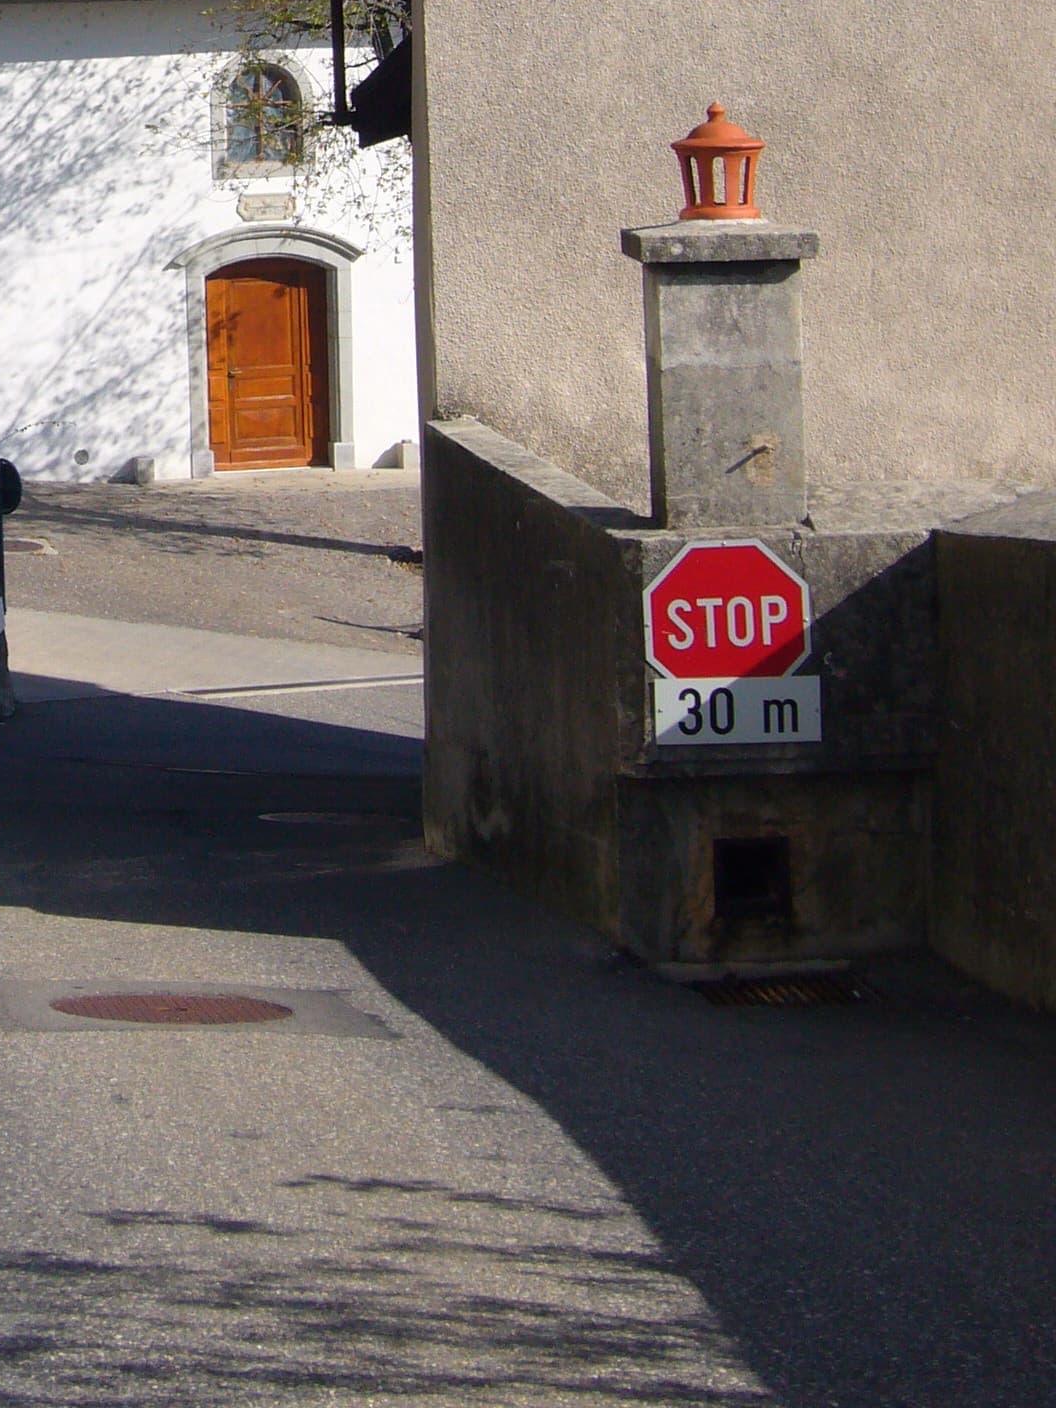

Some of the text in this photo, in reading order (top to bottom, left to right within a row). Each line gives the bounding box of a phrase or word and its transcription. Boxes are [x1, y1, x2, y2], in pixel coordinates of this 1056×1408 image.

[667, 595, 788, 650] STOP
[678, 687, 798, 735] 30 m
